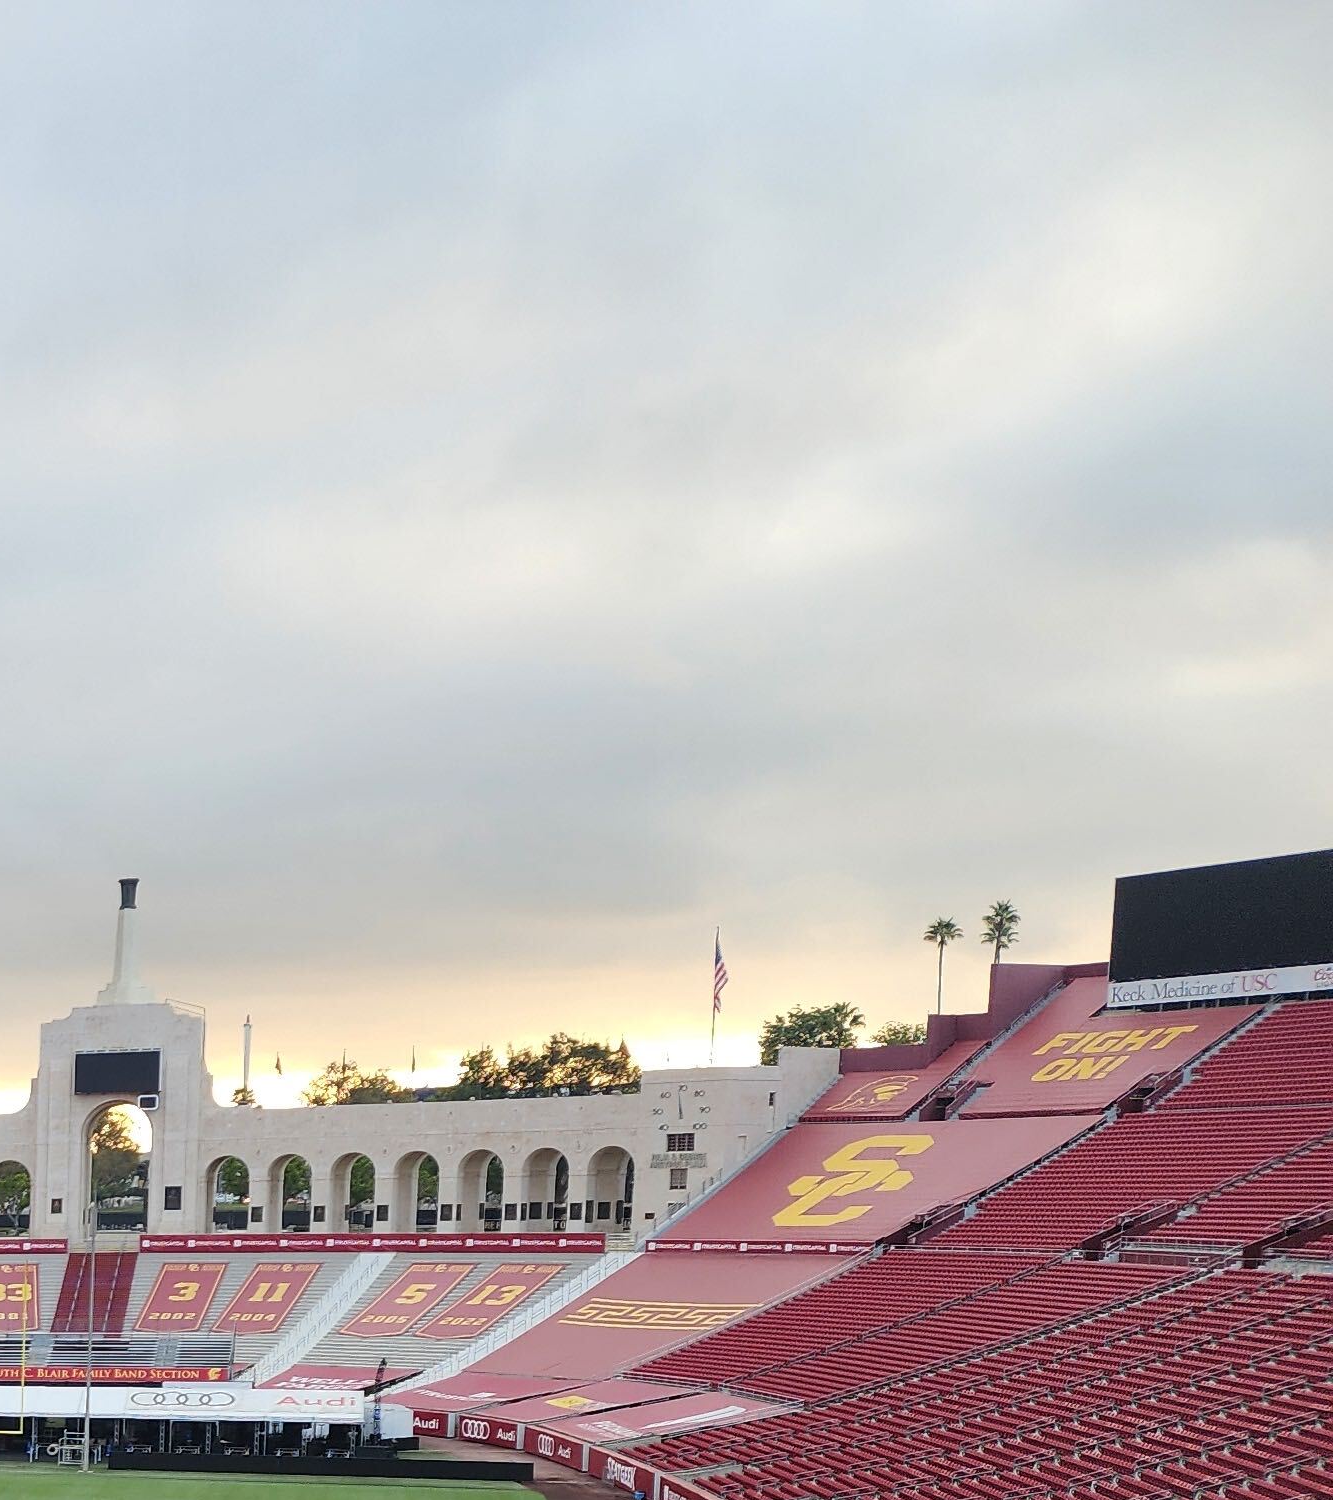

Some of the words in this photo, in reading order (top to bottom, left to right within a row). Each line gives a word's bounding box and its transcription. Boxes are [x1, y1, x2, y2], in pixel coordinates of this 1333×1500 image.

[1111, 984, 1145, 1004] Keck
[1151, 980, 1218, 1000] Medicine
[1221, 975, 1236, 994] of
[1241, 973, 1278, 993] USC
[1032, 1025, 1199, 1056] FIGHT
[1031, 1055, 1130, 1082] ON!
[168, 1281, 201, 1301] 3
[248, 1282, 291, 1302] 11
[395, 1283, 437, 1305] 5
[465, 1284, 527, 1306] 13
[148, 1312, 196, 1320] 2002
[229, 1313, 277, 1321] 2004
[360, 1314, 410, 1324] 2005
[439, 1317, 488, 1326] 2022
[36, 1368, 69, 1378] BLAIR
[72, 1368, 112, 1378] FAMILY
[114, 1368, 147, 1378] BAND
[150, 1368, 200, 1379] SECTION
[276, 1396, 357, 1407] Audi
[413, 1416, 439, 1430] Audi
[497, 1428, 516, 1442] Audi
[557, 1444, 572, 1458] Audi
